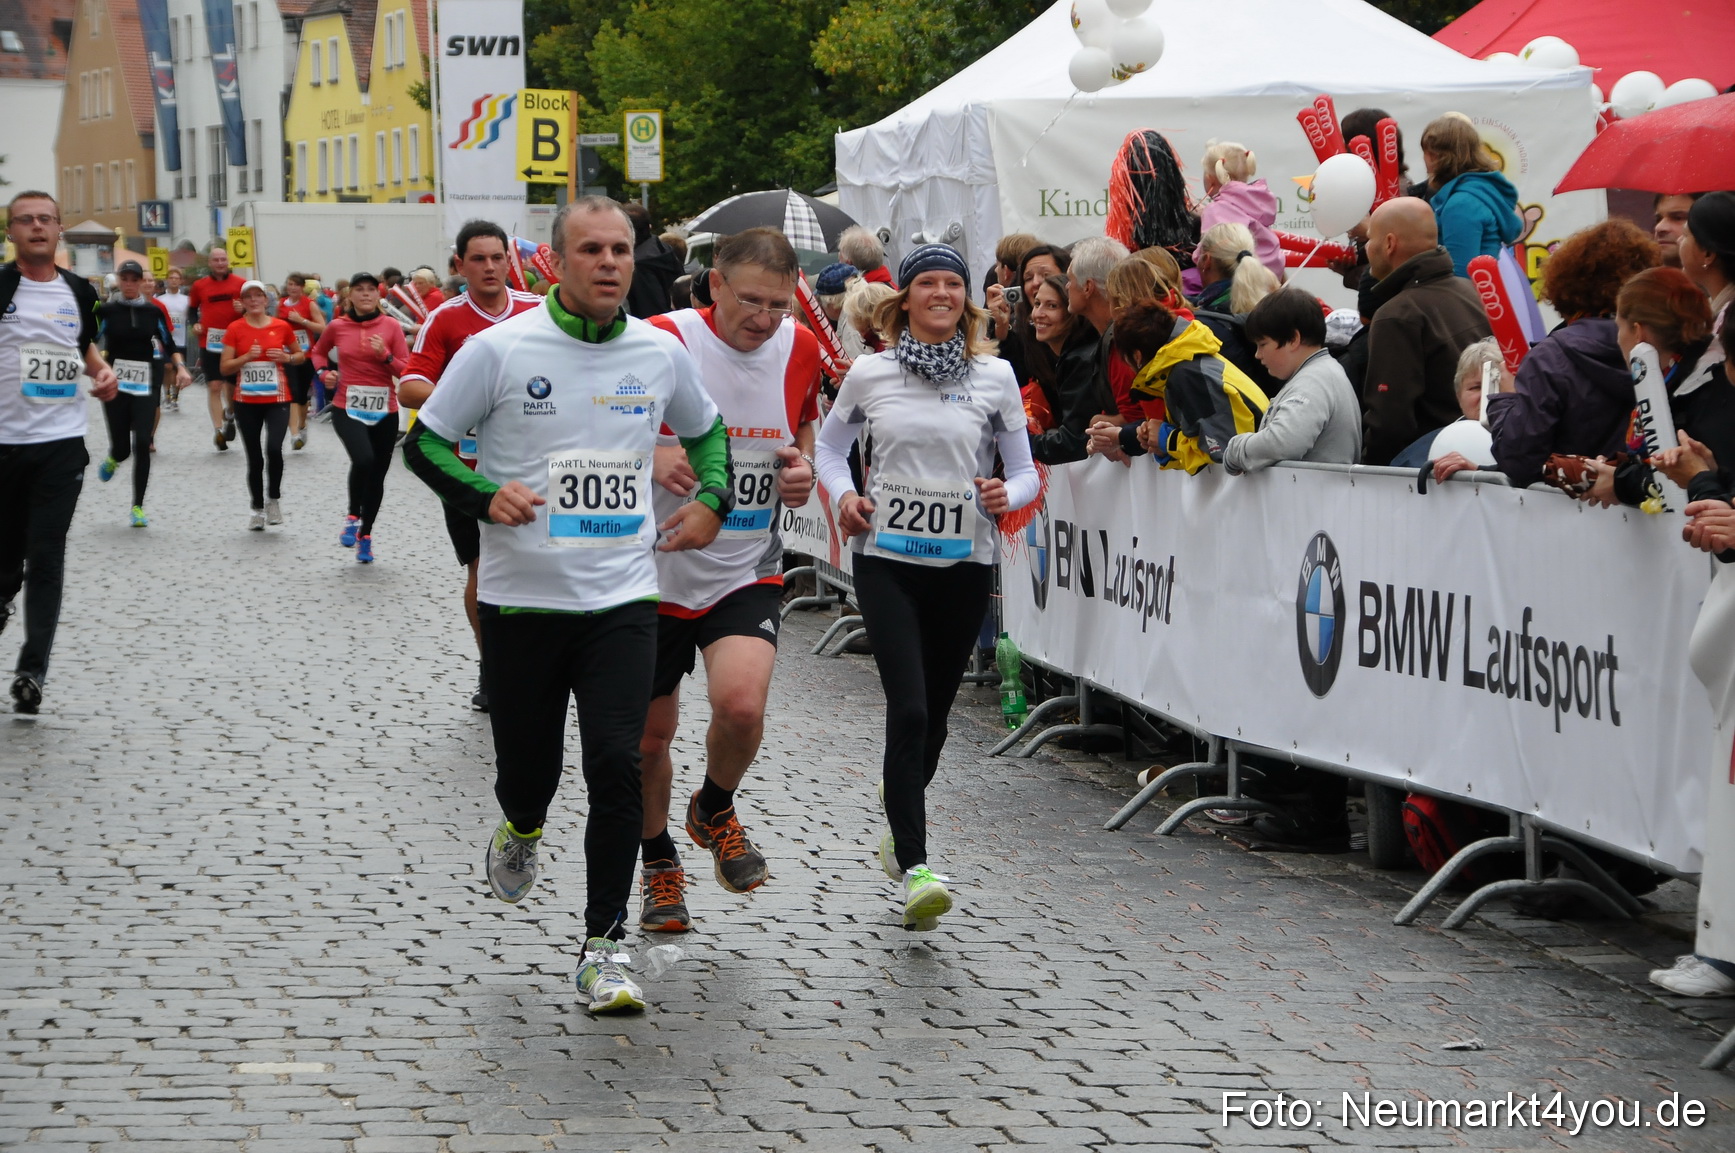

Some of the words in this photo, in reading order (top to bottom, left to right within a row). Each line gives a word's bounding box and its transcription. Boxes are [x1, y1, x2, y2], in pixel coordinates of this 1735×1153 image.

[446, 35, 520, 56] swn
[524, 93, 570, 111] Block
[532, 118, 561, 162] B
[233, 239, 247, 259] C
[153, 257, 164, 271] D
[28, 358, 79, 381] 2188
[116, 367, 146, 382] 2471
[244, 370, 273, 383] 3092
[350, 395, 384, 411] 2470
[523, 402, 556, 410] PARTL
[727, 426, 784, 440] KLEBL
[551, 460, 586, 469] PARTL
[588, 459, 632, 469] Neumarkt
[559, 473, 637, 510] 3035
[882, 483, 912, 495] PARTL
[914, 488, 960, 499] Neumarkt
[887, 497, 963, 535] 2201
[580, 519, 621, 534] Martin
[905, 540, 942, 555] Ulrike
[1358, 580, 1455, 682] BMW
[1463, 594, 1621, 734] Laufsport
